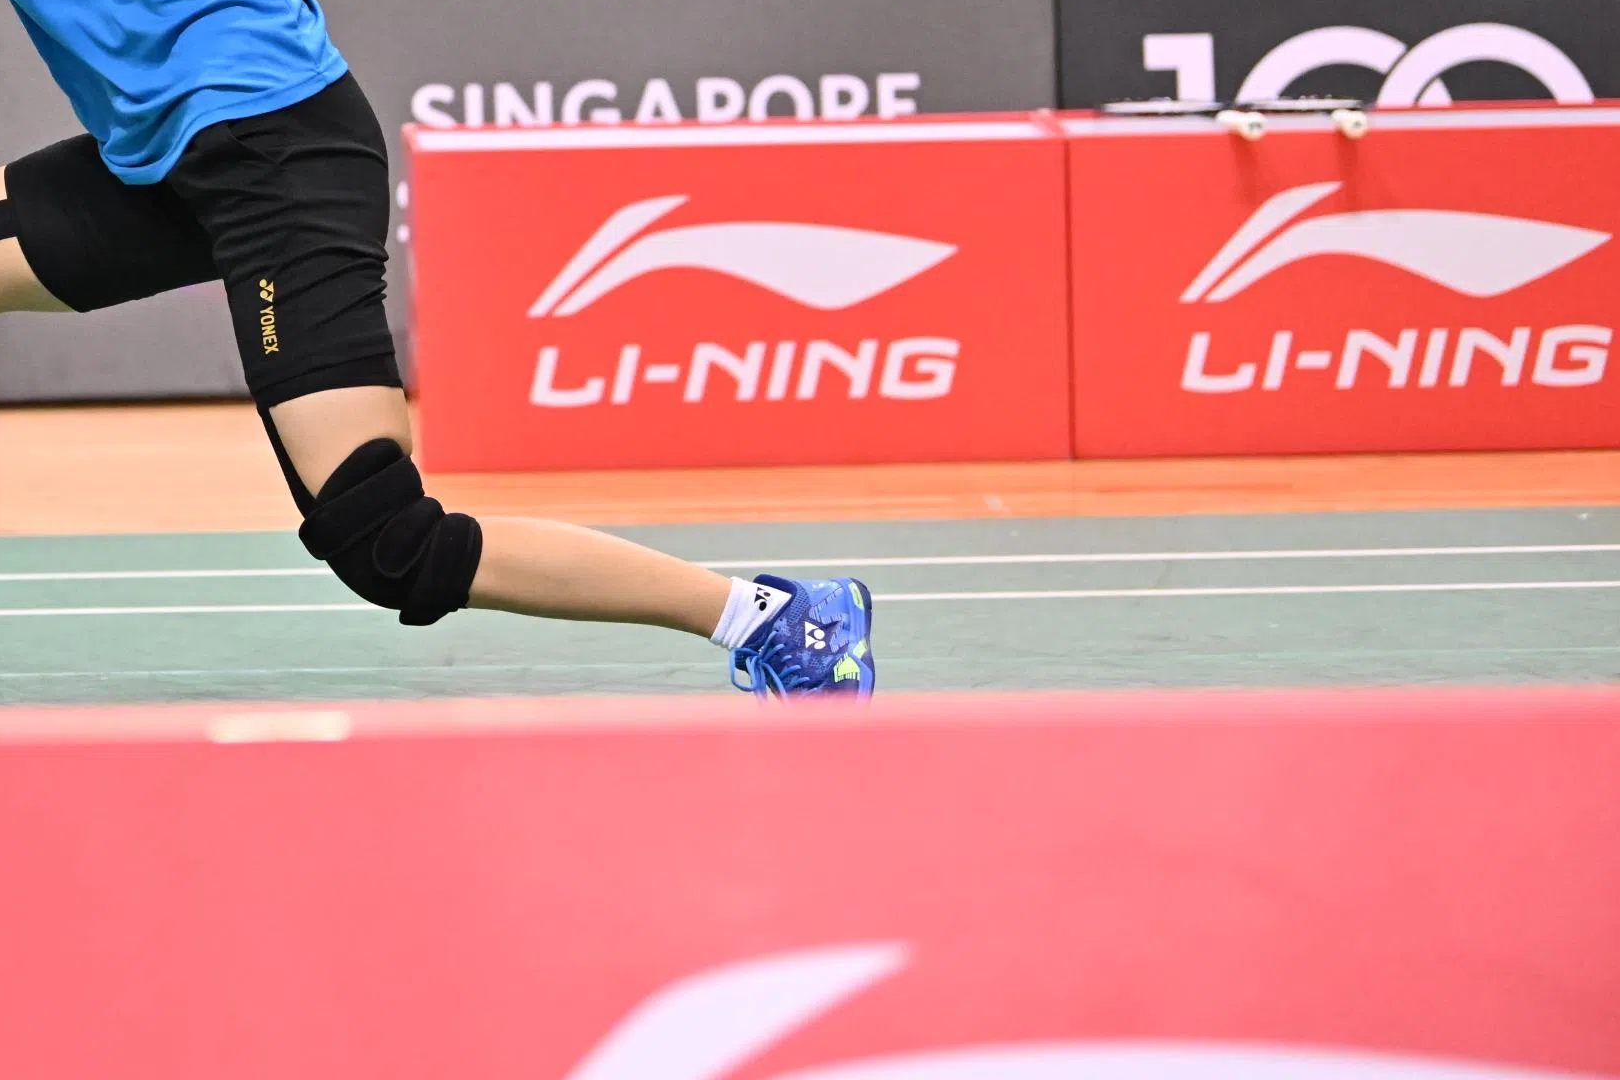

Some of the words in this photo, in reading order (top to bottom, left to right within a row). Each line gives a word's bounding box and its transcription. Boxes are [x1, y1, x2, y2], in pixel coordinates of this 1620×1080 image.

[410, 72, 921, 129] SINGAPORE
[259, 305, 280, 355] YONEX
[1180, 324, 1613, 394] LI-NING
[528, 336, 961, 408] LI-NING
